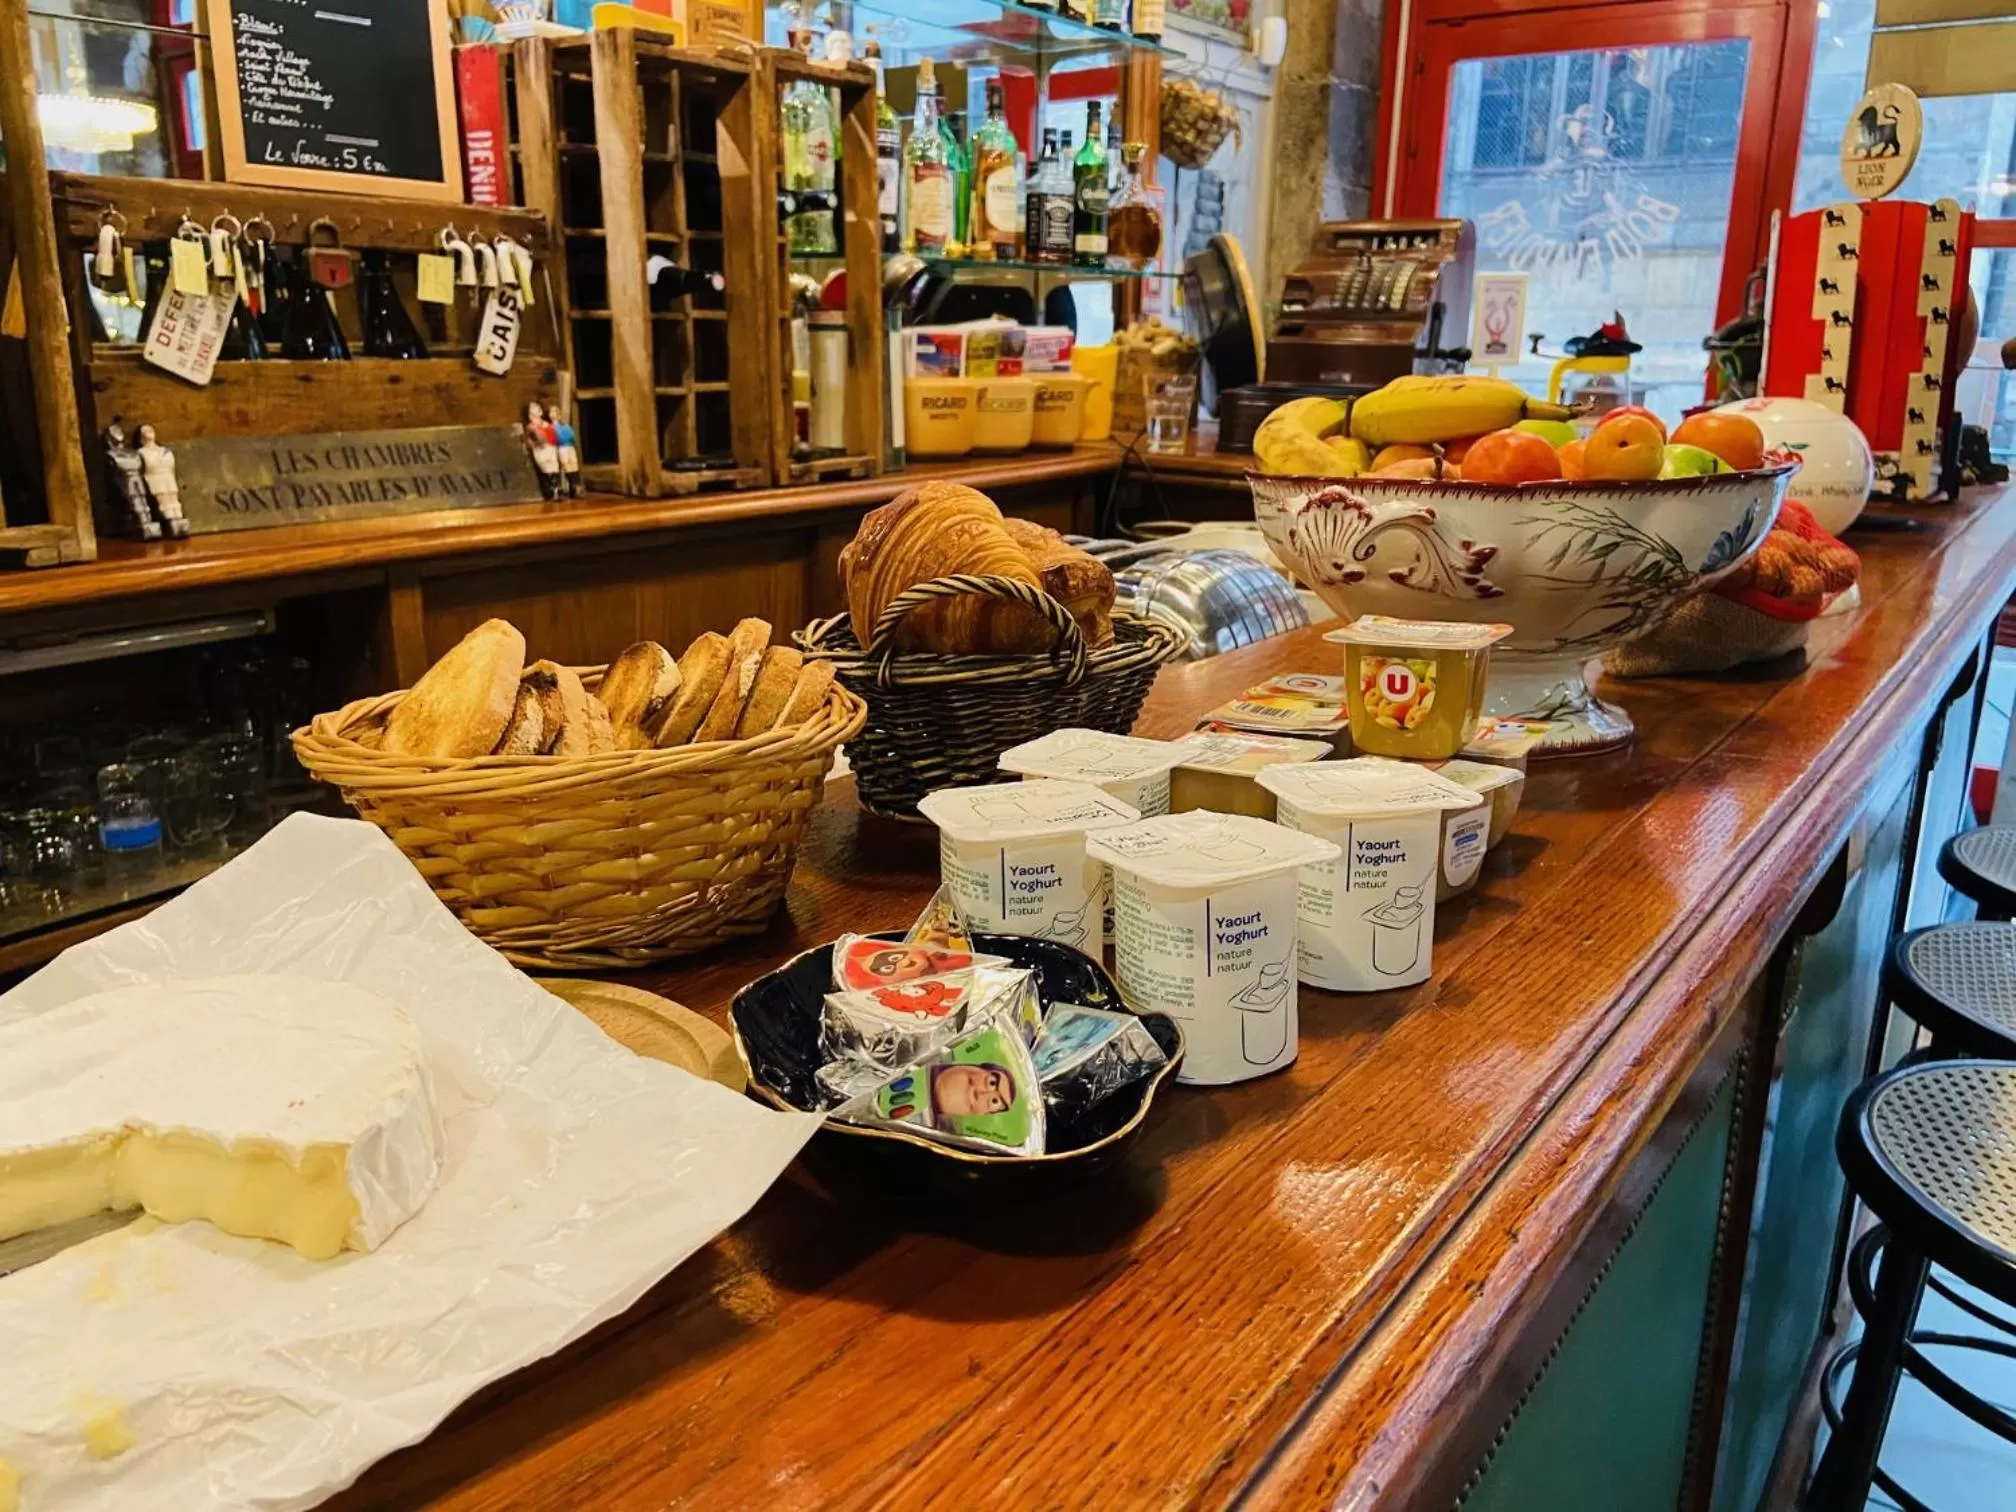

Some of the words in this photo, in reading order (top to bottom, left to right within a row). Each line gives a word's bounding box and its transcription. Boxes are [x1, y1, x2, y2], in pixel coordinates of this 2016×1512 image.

[265, 141, 284, 162] Le
[343, 149, 357, 169] 5
[921, 396, 967, 409] RICARD
[272, 449, 318, 475] LES
[325, 440, 452, 471] CHAMBRES
[214, 486, 289, 514] SONT
[293, 476, 408, 509] PAYABLES
[1387, 673, 1409, 695] U
[1356, 839, 1400, 851] Yaourt
[1356, 852, 1406, 868] Yoghurt
[1009, 863, 1056, 877] Yaourt
[1354, 868, 1388, 878] nature
[1009, 876, 1063, 893] Yoghurt
[1353, 879, 1387, 890] natuur
[1008, 894, 1044, 905] nature
[1009, 905, 1043, 916] natuur
[1215, 911, 1262, 929] Yaourt
[1215, 925, 1269, 946] Yoghurt
[1216, 947, 1253, 961] nature
[1216, 959, 1253, 974] natuur
